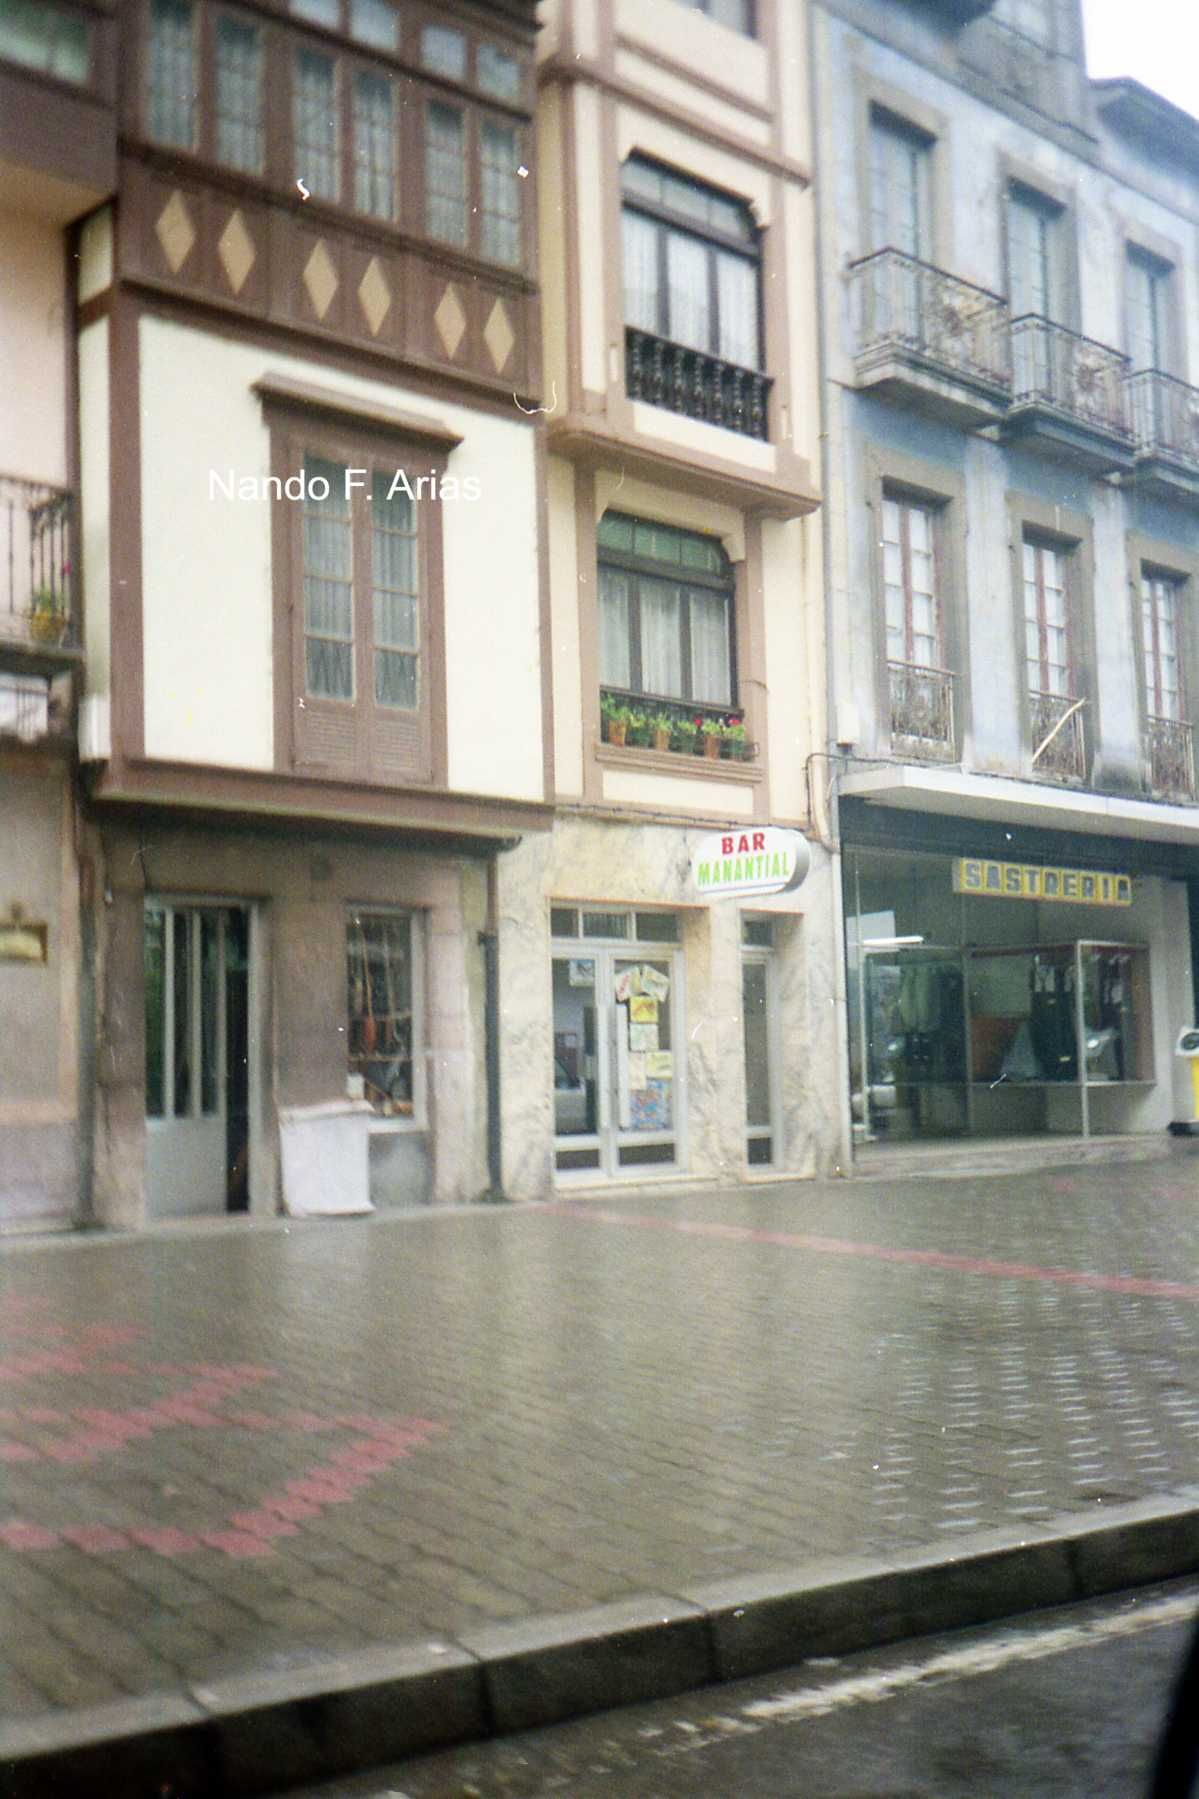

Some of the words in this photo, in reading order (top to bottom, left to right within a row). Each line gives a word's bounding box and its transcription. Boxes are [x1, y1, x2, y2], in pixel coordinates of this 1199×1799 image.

[721, 831, 765, 855] BAR
[697, 850, 790, 886] MANANTIAL
[965, 862, 1129, 901] SASTRERIA
